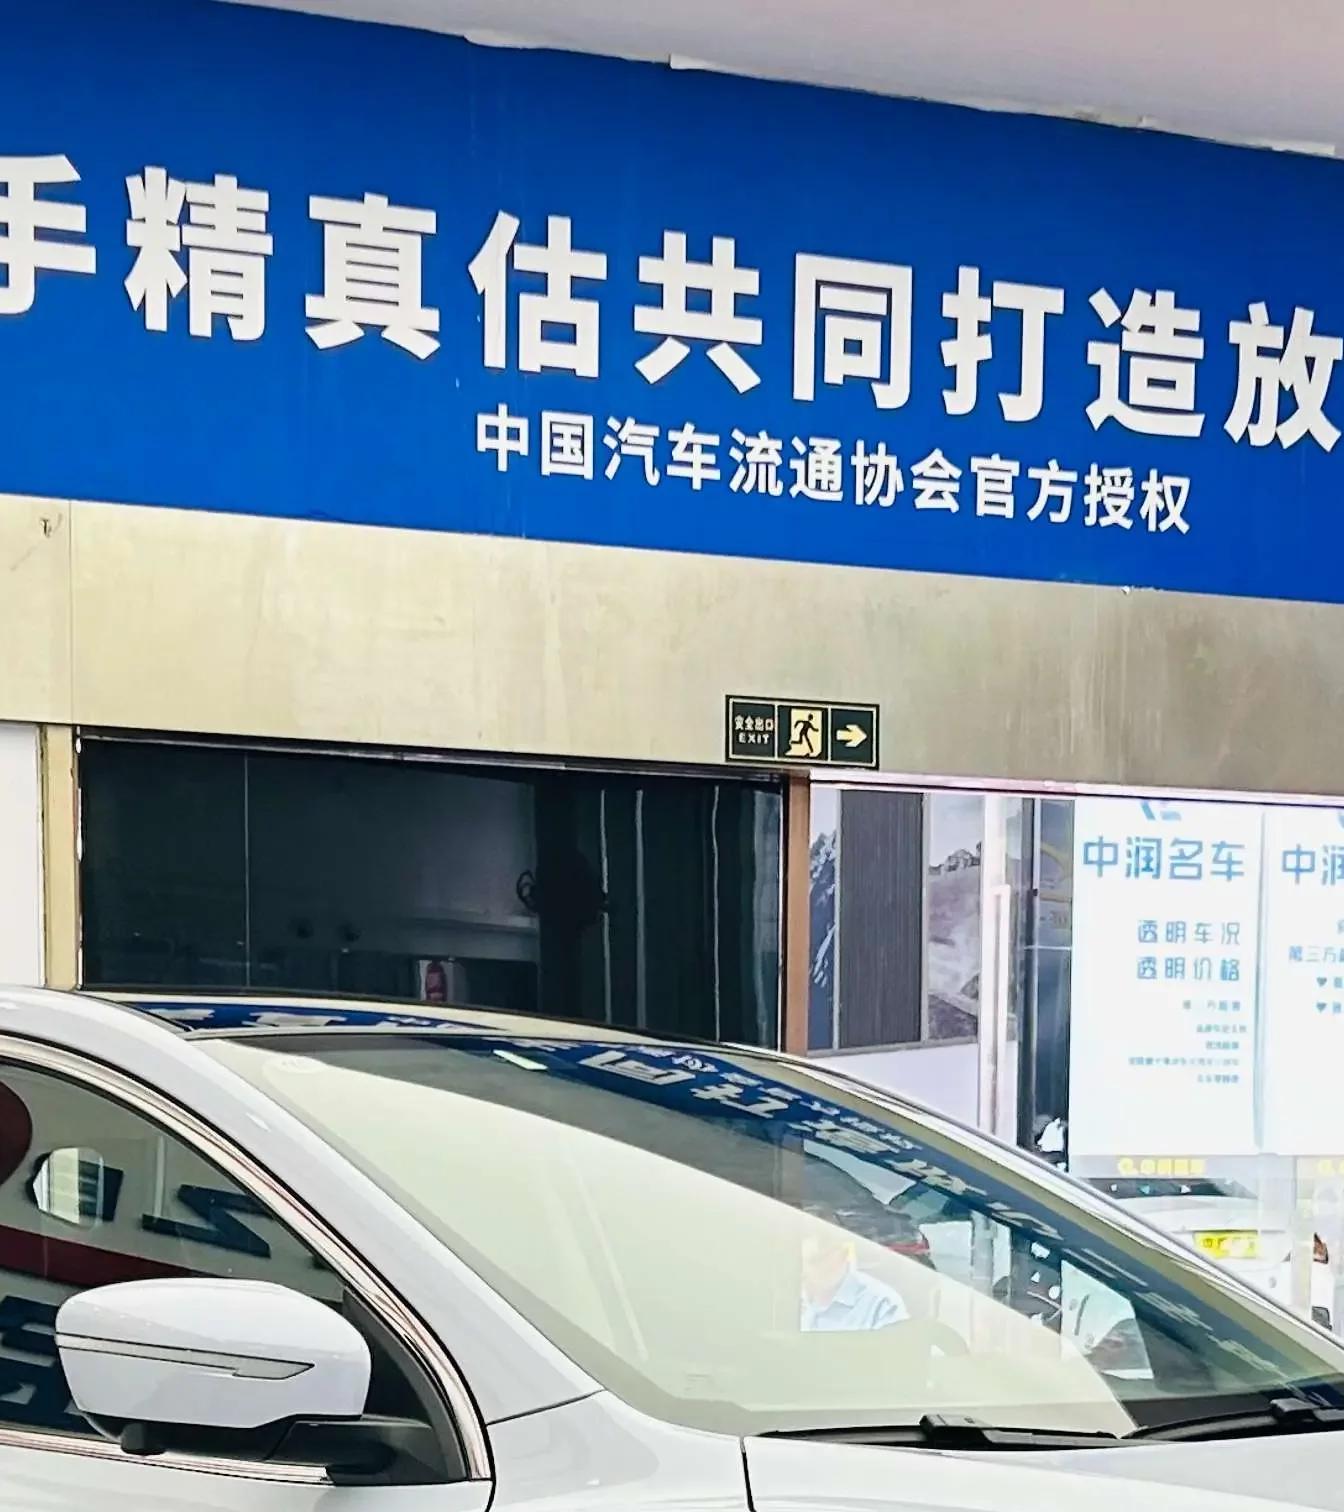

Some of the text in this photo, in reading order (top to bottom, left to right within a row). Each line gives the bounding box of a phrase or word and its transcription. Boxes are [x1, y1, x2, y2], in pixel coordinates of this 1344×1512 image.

[476, 403, 1191, 534] 中国汽车流通协会官方授权
[739, 732, 770, 745] EXIT
[1082, 835, 1246, 882] 中润名车
